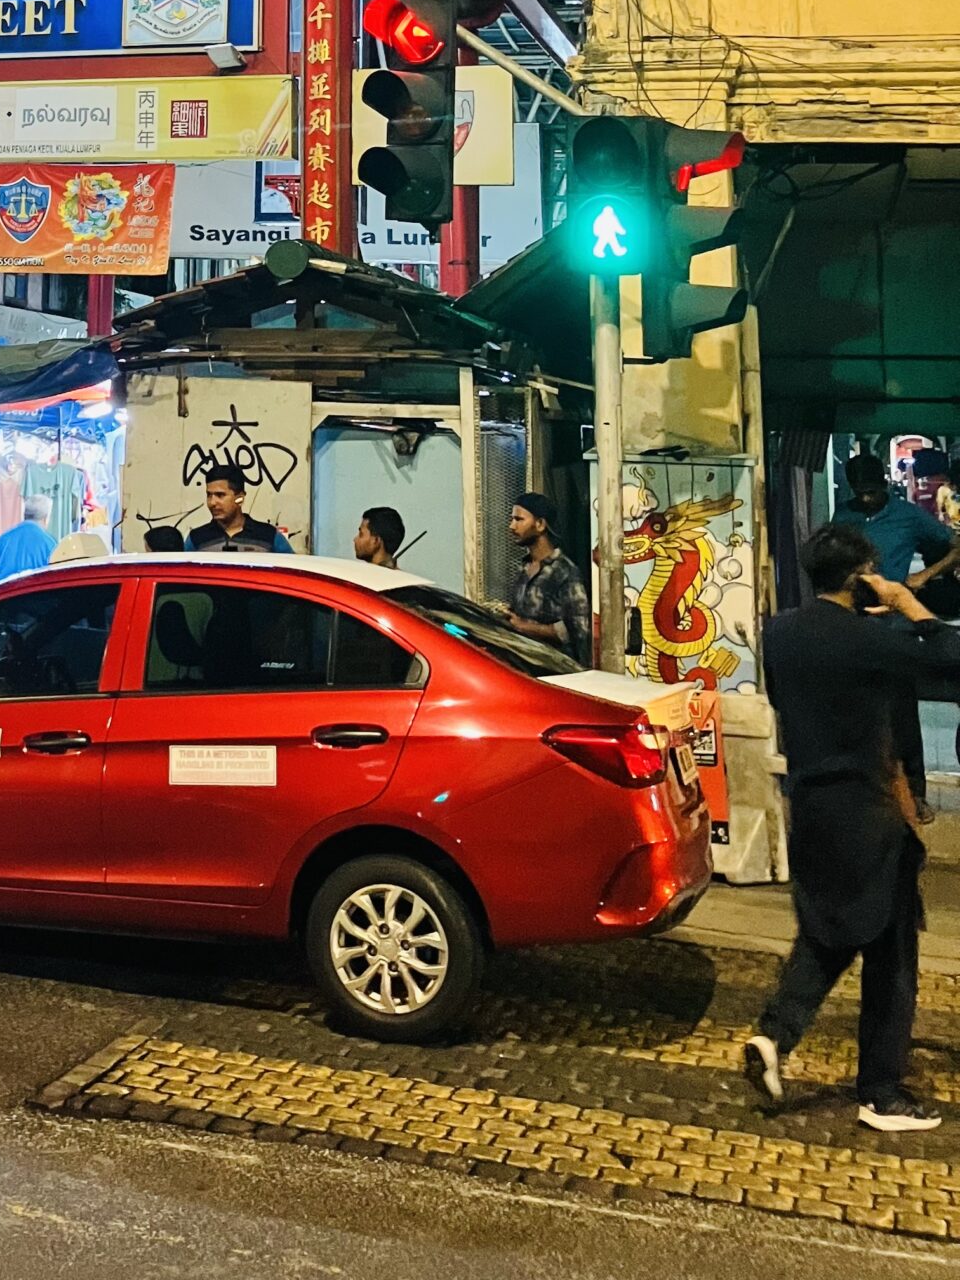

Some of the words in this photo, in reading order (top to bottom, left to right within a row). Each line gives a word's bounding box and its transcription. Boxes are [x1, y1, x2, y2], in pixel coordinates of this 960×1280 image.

[136, 90, 157, 149] 丙申年
[189, 224, 291, 247] Sayangi
